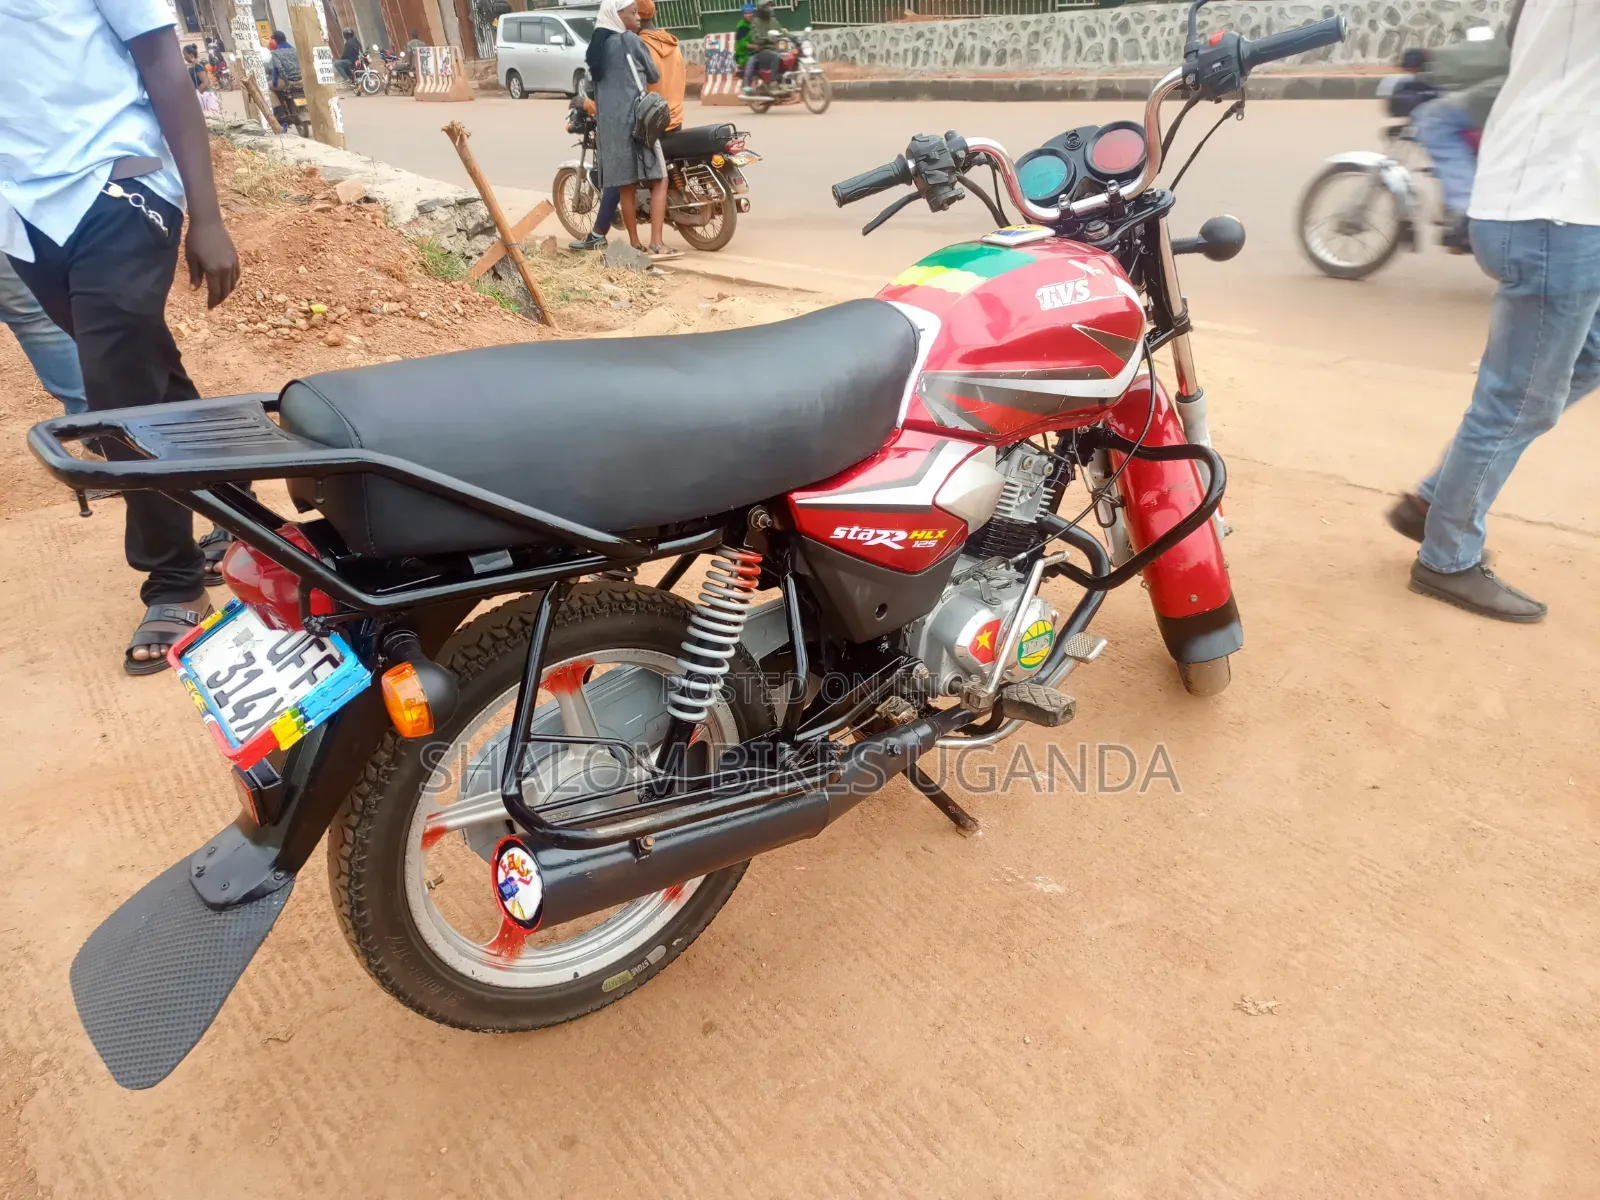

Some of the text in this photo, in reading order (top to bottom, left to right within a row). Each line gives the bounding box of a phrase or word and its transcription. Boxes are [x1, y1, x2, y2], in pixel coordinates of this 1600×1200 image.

[1036, 279, 1091, 311] TVS
[908, 529, 947, 540] HLX
[911, 540, 938, 548] 125
